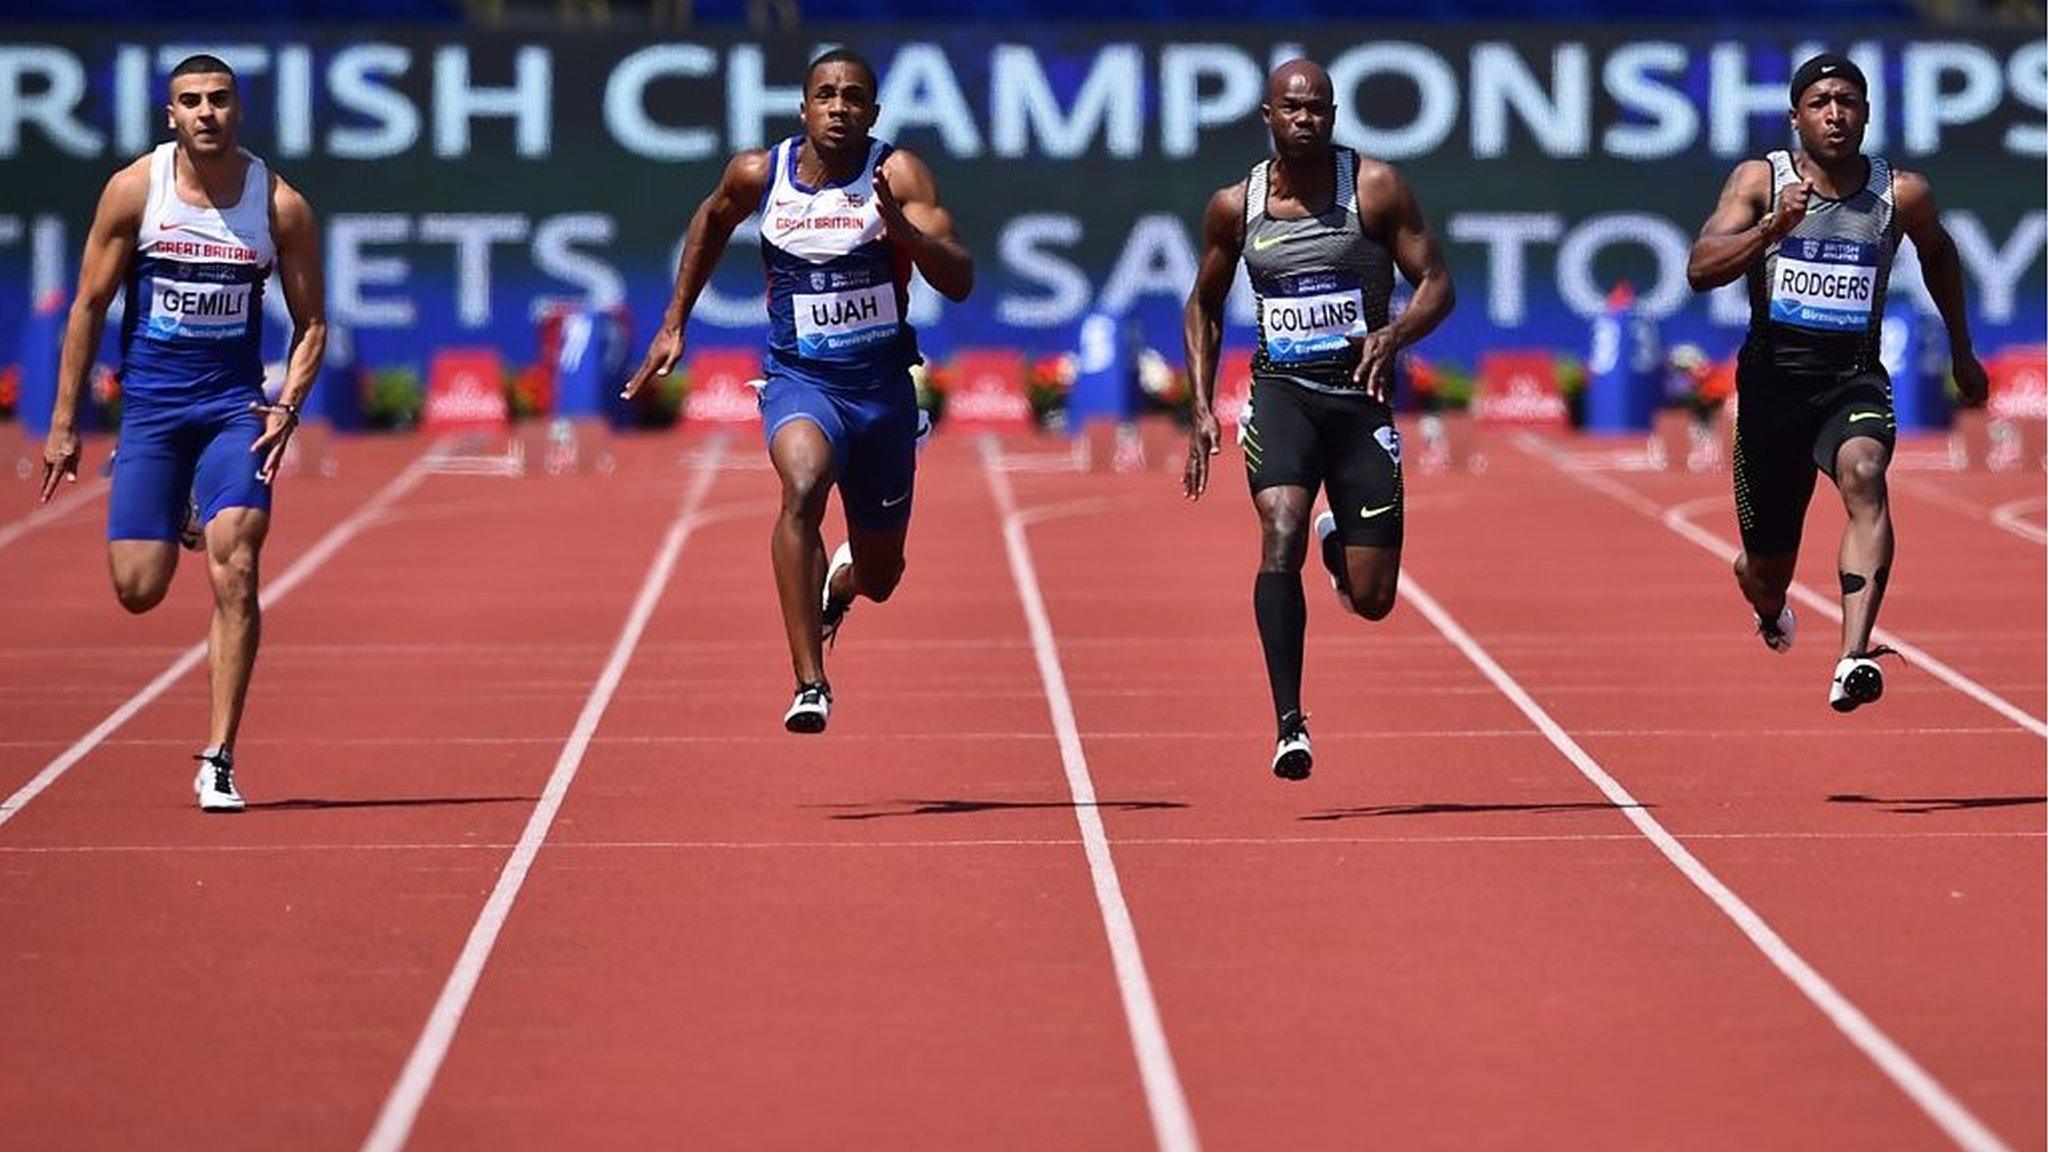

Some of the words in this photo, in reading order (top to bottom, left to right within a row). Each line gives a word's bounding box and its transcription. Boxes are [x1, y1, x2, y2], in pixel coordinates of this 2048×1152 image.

[603, 39, 2046, 160] CHAMPONSHIP
[815, 216, 864, 230] BRITAIN
[156, 241, 201, 257] GREAT
[204, 245, 257, 262] BRITAIN
[1780, 268, 1871, 301] RODGERS
[162, 289, 244, 316] GEMILI
[812, 296, 878, 326] UJAH
[1270, 300, 1358, 332] COLLINS
[1800, 307, 1867, 325] Birmingham
[827, 328, 897, 348] Birmingham
